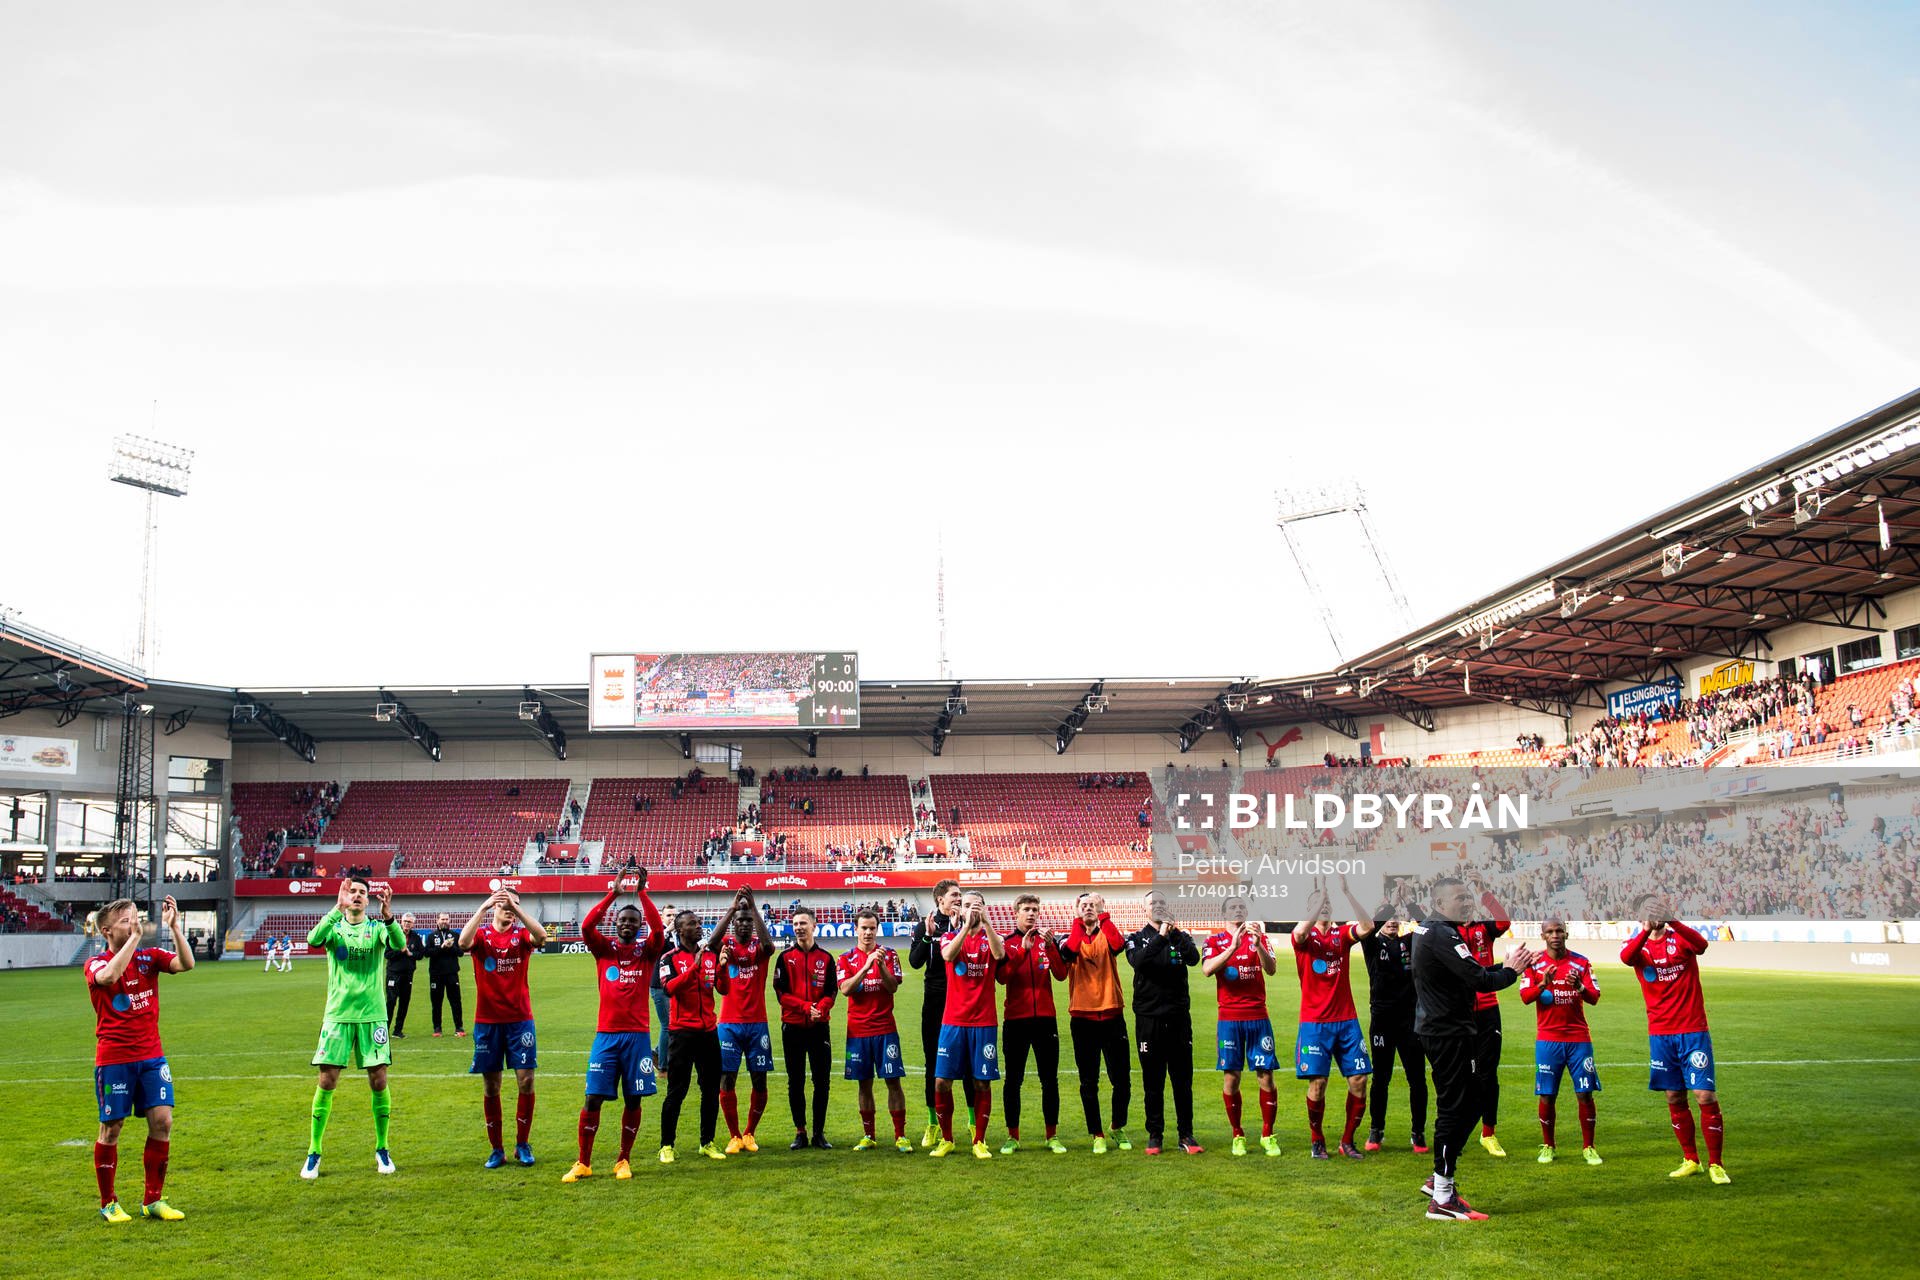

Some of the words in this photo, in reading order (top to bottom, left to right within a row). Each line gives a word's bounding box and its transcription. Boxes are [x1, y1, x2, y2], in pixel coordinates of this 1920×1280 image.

[820, 664, 825, 674] 1
[843, 664, 851, 675] 0
[1700, 659, 1755, 696] WALLIN
[818, 680, 854, 693] 90:00
[830, 705, 838, 715] 4
[840, 707, 857, 716] min
[434, 879, 455, 887] Resurs
[687, 876, 729, 888] RAMLÖSA
[765, 875, 808, 887] RAMLÖSA
[844, 873, 887, 886] RAMLÖSA
[497, 957, 521, 965] Resurs
[497, 964, 515, 972] Bank
[1239, 965, 1261, 973] Resurs
[1656, 963, 1685, 975] Resurs
[1658, 972, 1678, 982] Bank
[864, 984, 880, 992] Bank
[128, 988, 154, 1002] Resurs
[1554, 996, 1573, 1005] Bank
[132, 998, 150, 1011] Bank
[1140, 1041, 1148, 1052] JE
[1373, 1035, 1385, 1047] CA
[374, 1049, 379, 1060] 1
[520, 1053, 527, 1064] 3
[757, 1056, 766, 1066] 33
[1255, 1055, 1265, 1067] 22
[1354, 1058, 1366, 1070] 26
[884, 1063, 893, 1074] 10
[981, 1063, 987, 1075] 4
[1579, 1077, 1589, 1089] 14
[1690, 1072, 1696, 1085] 8
[112, 1083, 127, 1091] Solid
[635, 1079, 644, 1091] 18
[160, 1087, 166, 1100] 6
